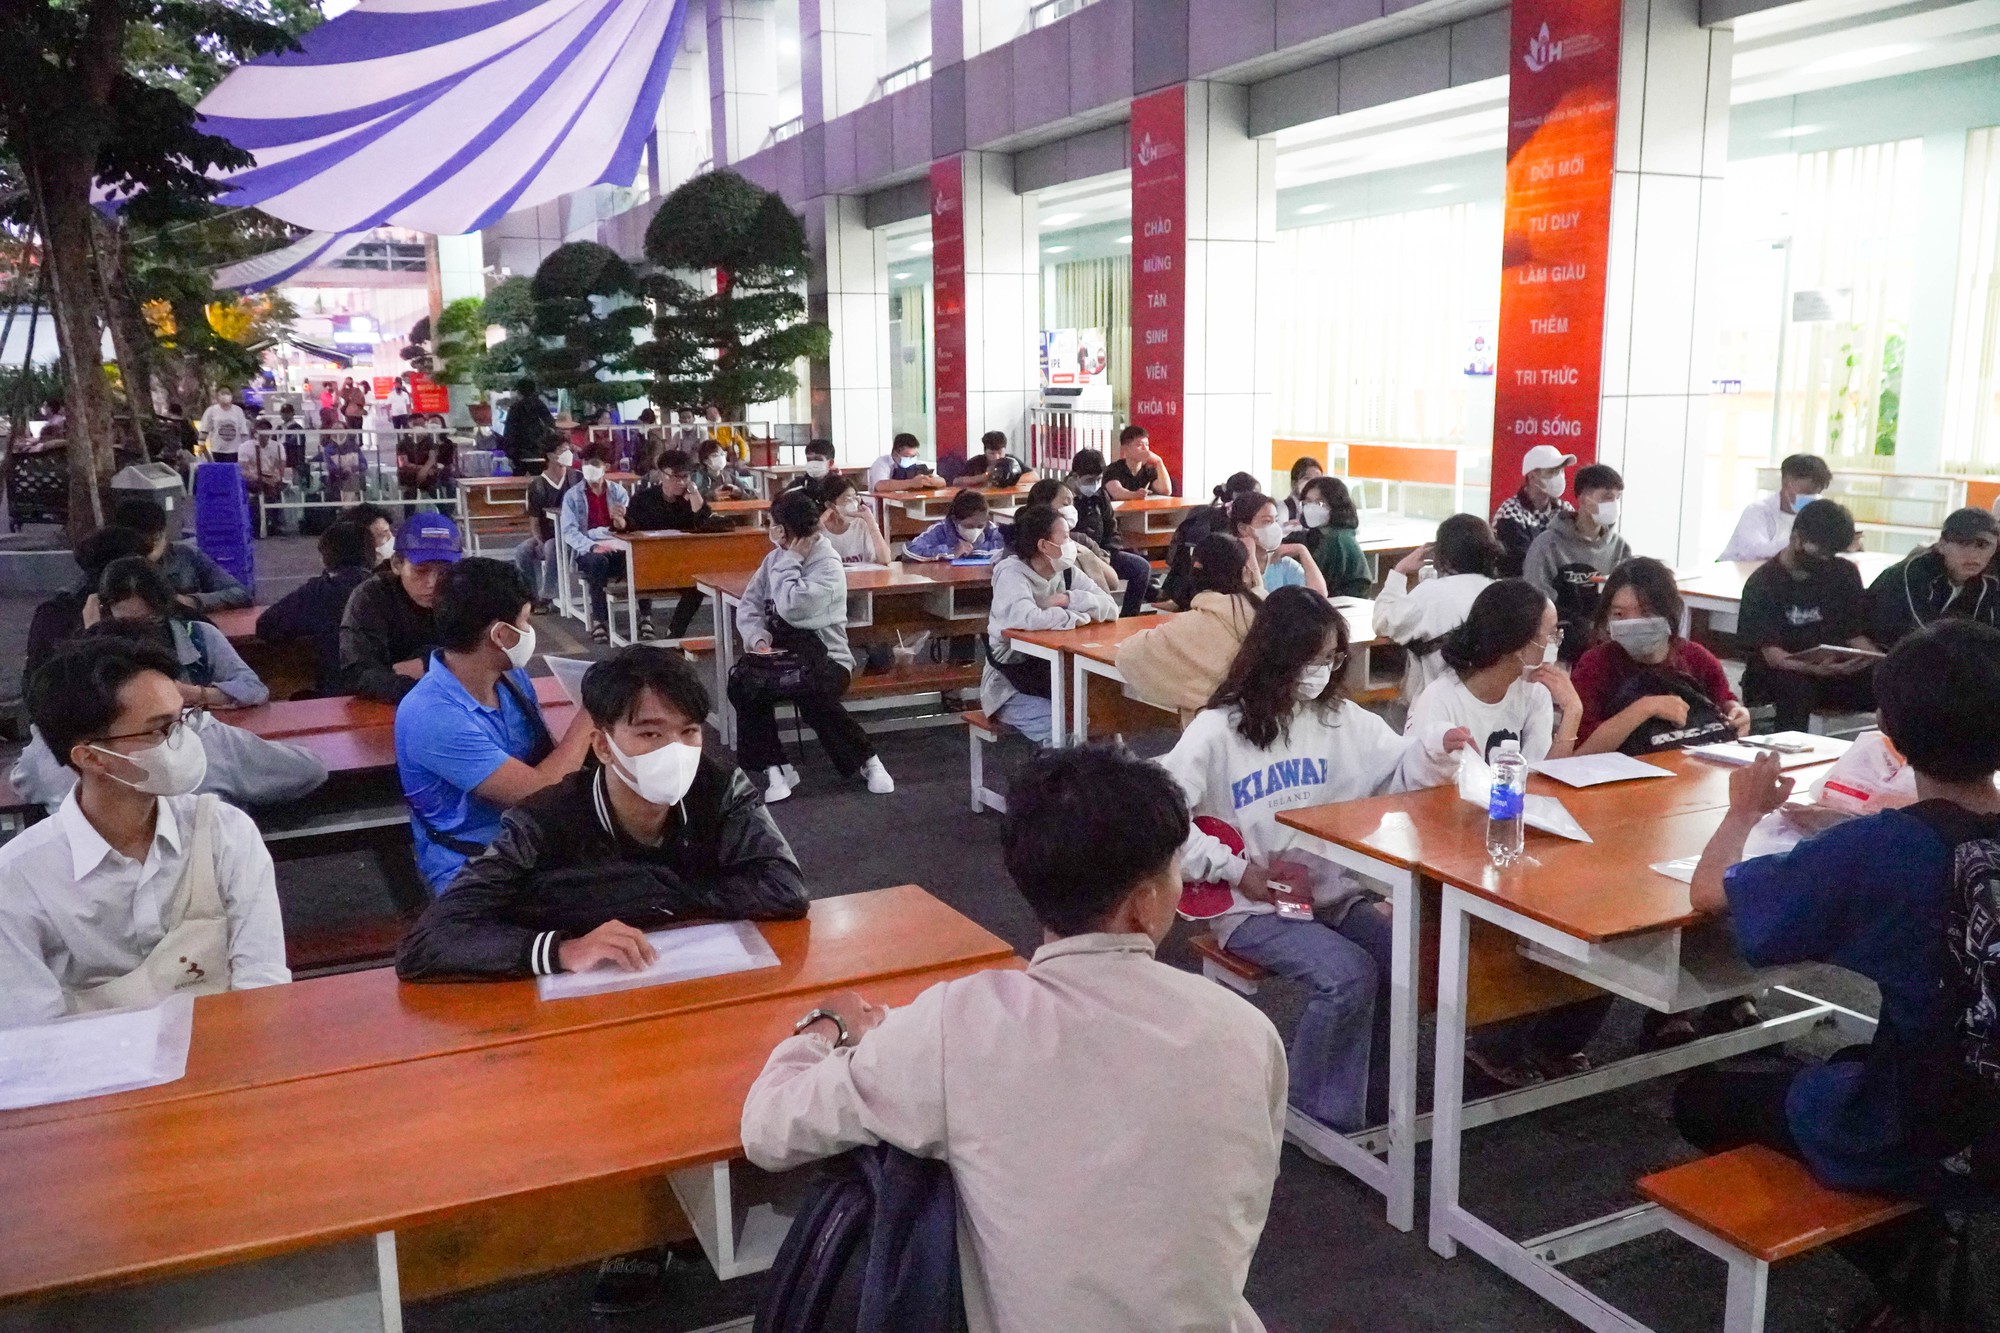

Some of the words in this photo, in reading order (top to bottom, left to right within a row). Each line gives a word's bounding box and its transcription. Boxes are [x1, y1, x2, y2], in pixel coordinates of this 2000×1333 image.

[1551, 210, 1580, 231] DUY
[1518, 264, 1547, 285] LÀM
[1551, 263, 1586, 282] GIÀU
[1147, 289, 1167, 308] TÂN
[1530, 315, 1569, 334] THÊM
[1145, 329, 1168, 345] SINH
[1145, 361, 1168, 380] VIÊN
[1515, 370, 1537, 386] TRI
[1540, 364, 1579, 385] THỨC
[1137, 395, 1163, 415] KHÓA
[1166, 401, 1177, 416] 19
[1514, 416, 1538, 435] ĐỜI
[1541, 413, 1581, 436] SỐNG
[1268, 791, 1311, 808] ISLAND
